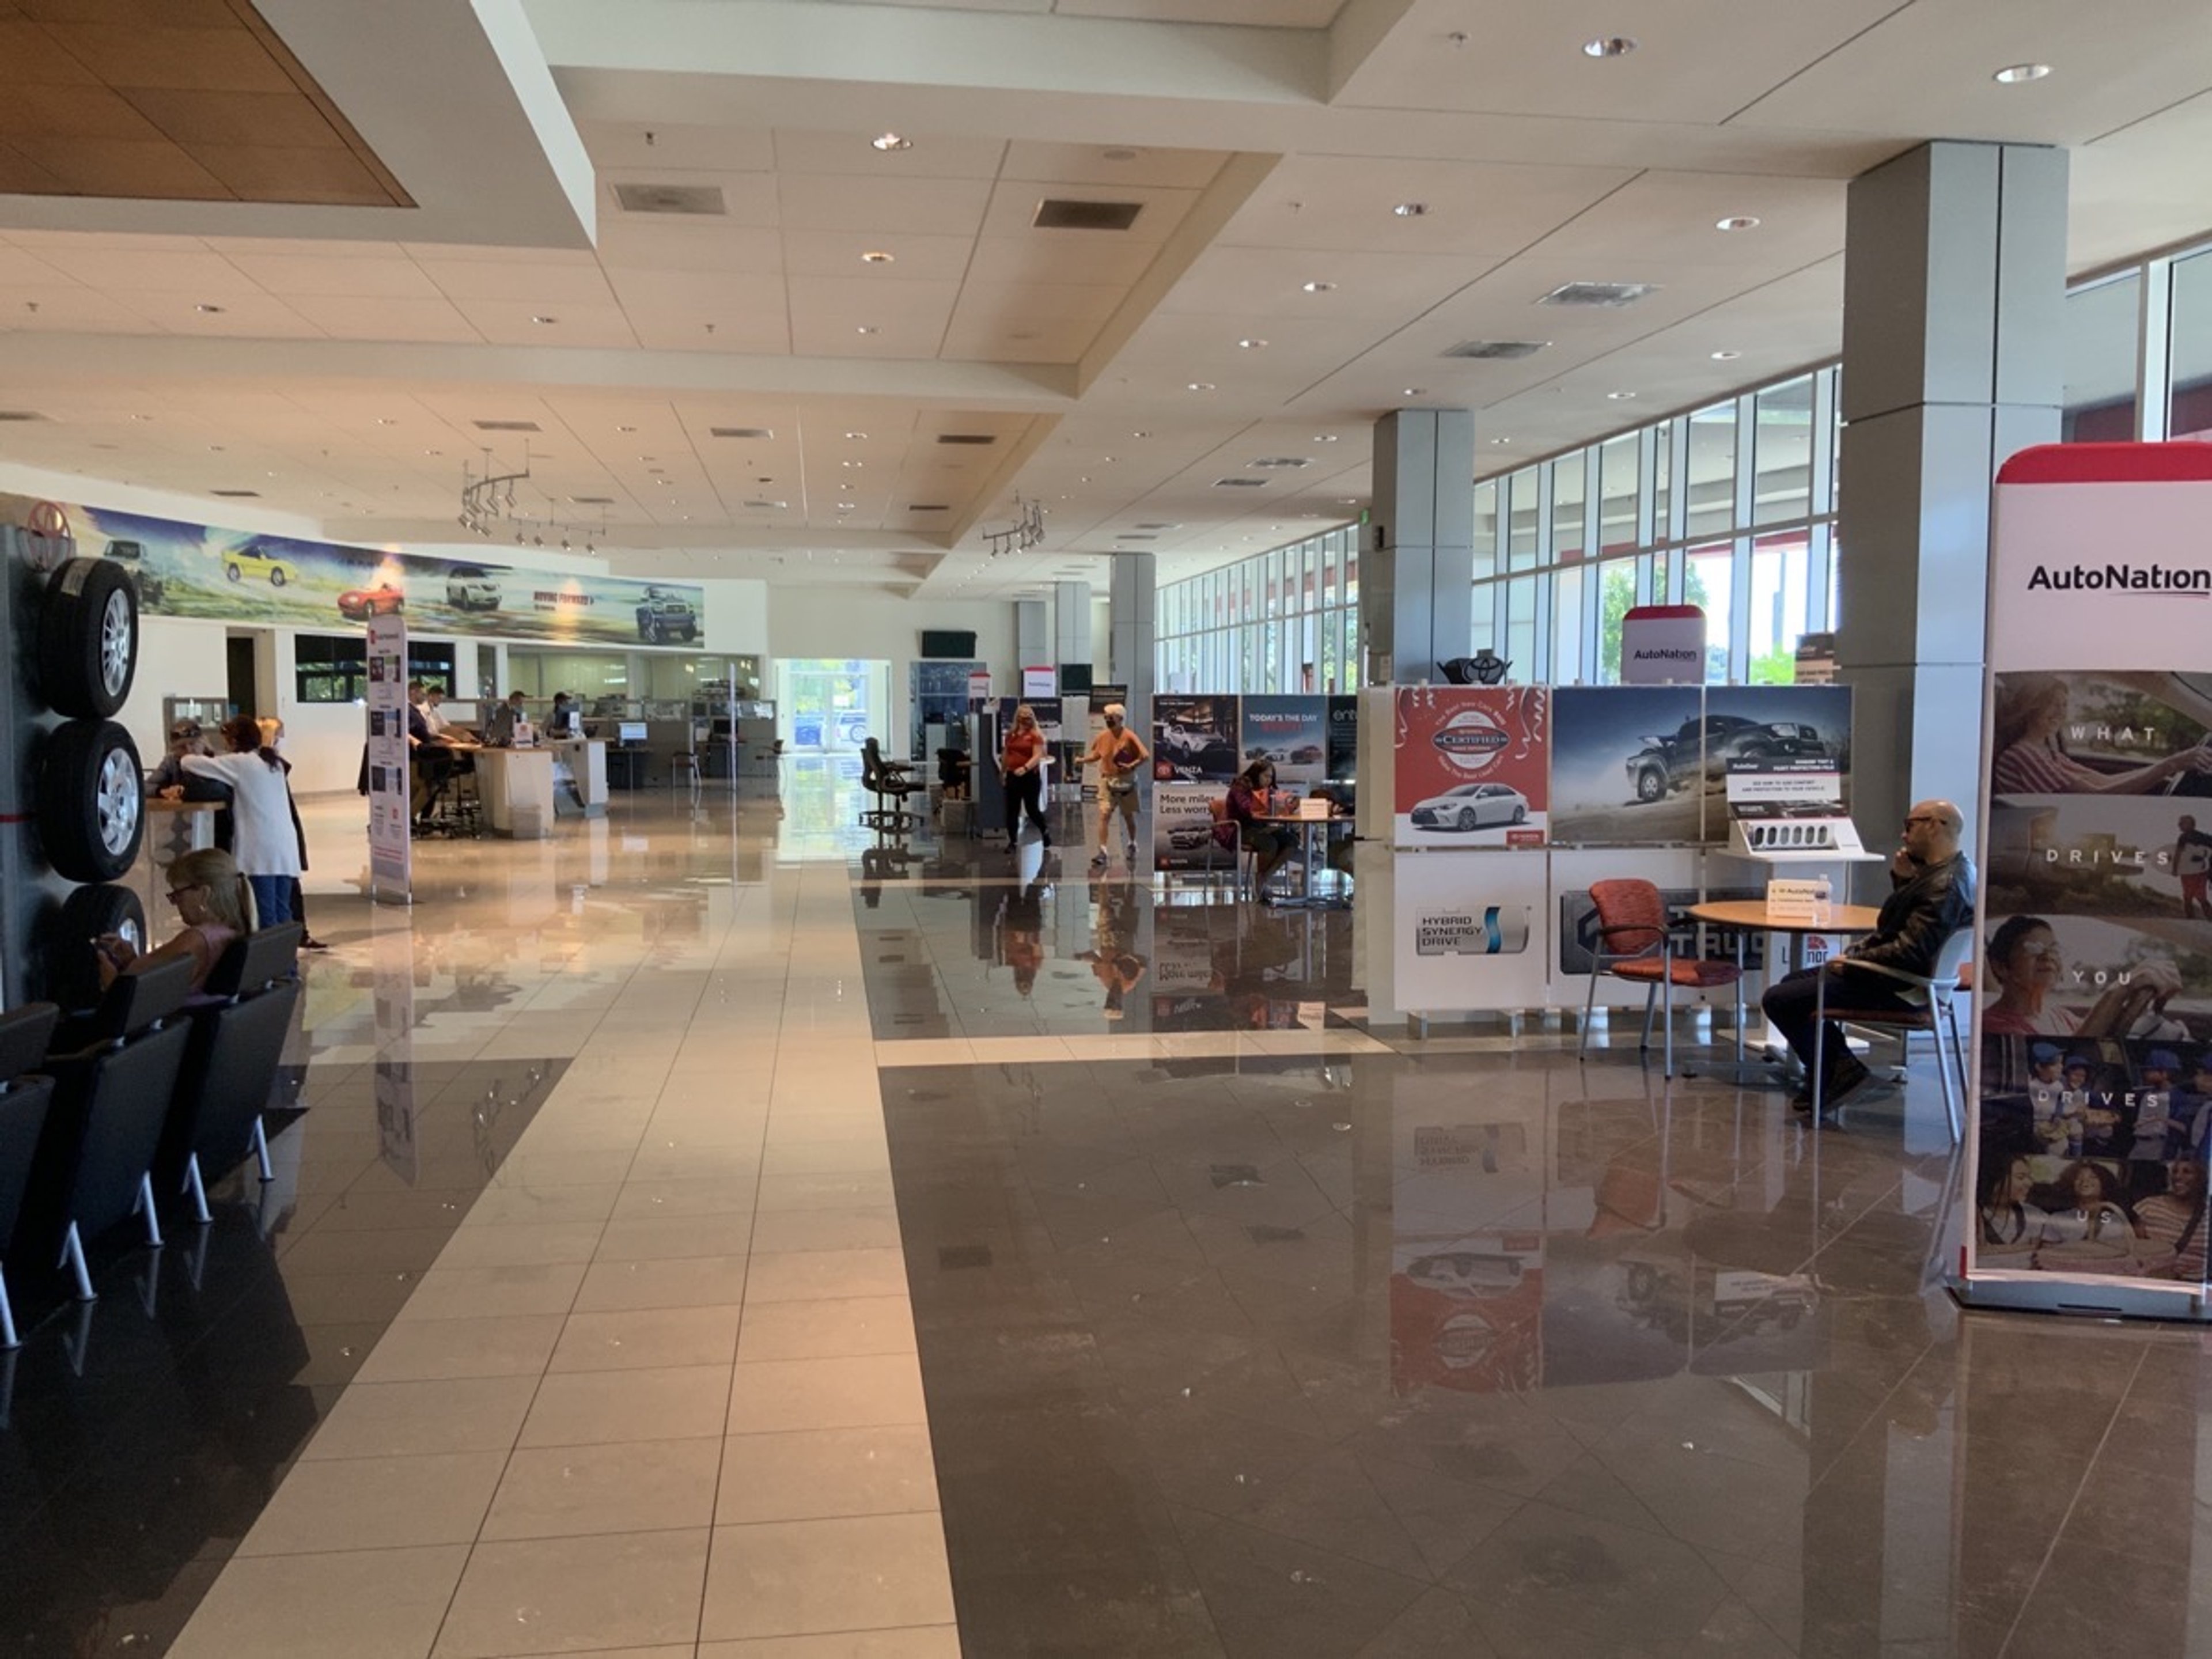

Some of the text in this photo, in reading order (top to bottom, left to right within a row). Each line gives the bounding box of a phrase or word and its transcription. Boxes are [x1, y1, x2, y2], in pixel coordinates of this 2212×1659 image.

[2028, 563, 2211, 590] AutoNation
[1634, 649, 1696, 659] AutoNation
[1249, 713, 1317, 722] TODAY'S THE DAY
[1332, 709, 1357, 721] ent
[2070, 727, 2156, 741] WHAT
[1174, 766, 1203, 774] VENZA
[1160, 794, 1185, 803] More
[2046, 849, 2170, 865] DRIVES
[1422, 916, 1472, 926] HYBRID
[1422, 926, 1483, 936] SYNERGY
[1422, 937, 1461, 946] DRIVE
[2073, 971, 2132, 985] YOU
[2038, 1090, 2158, 1107] DRIVES
[2077, 1211, 2111, 1224] US
